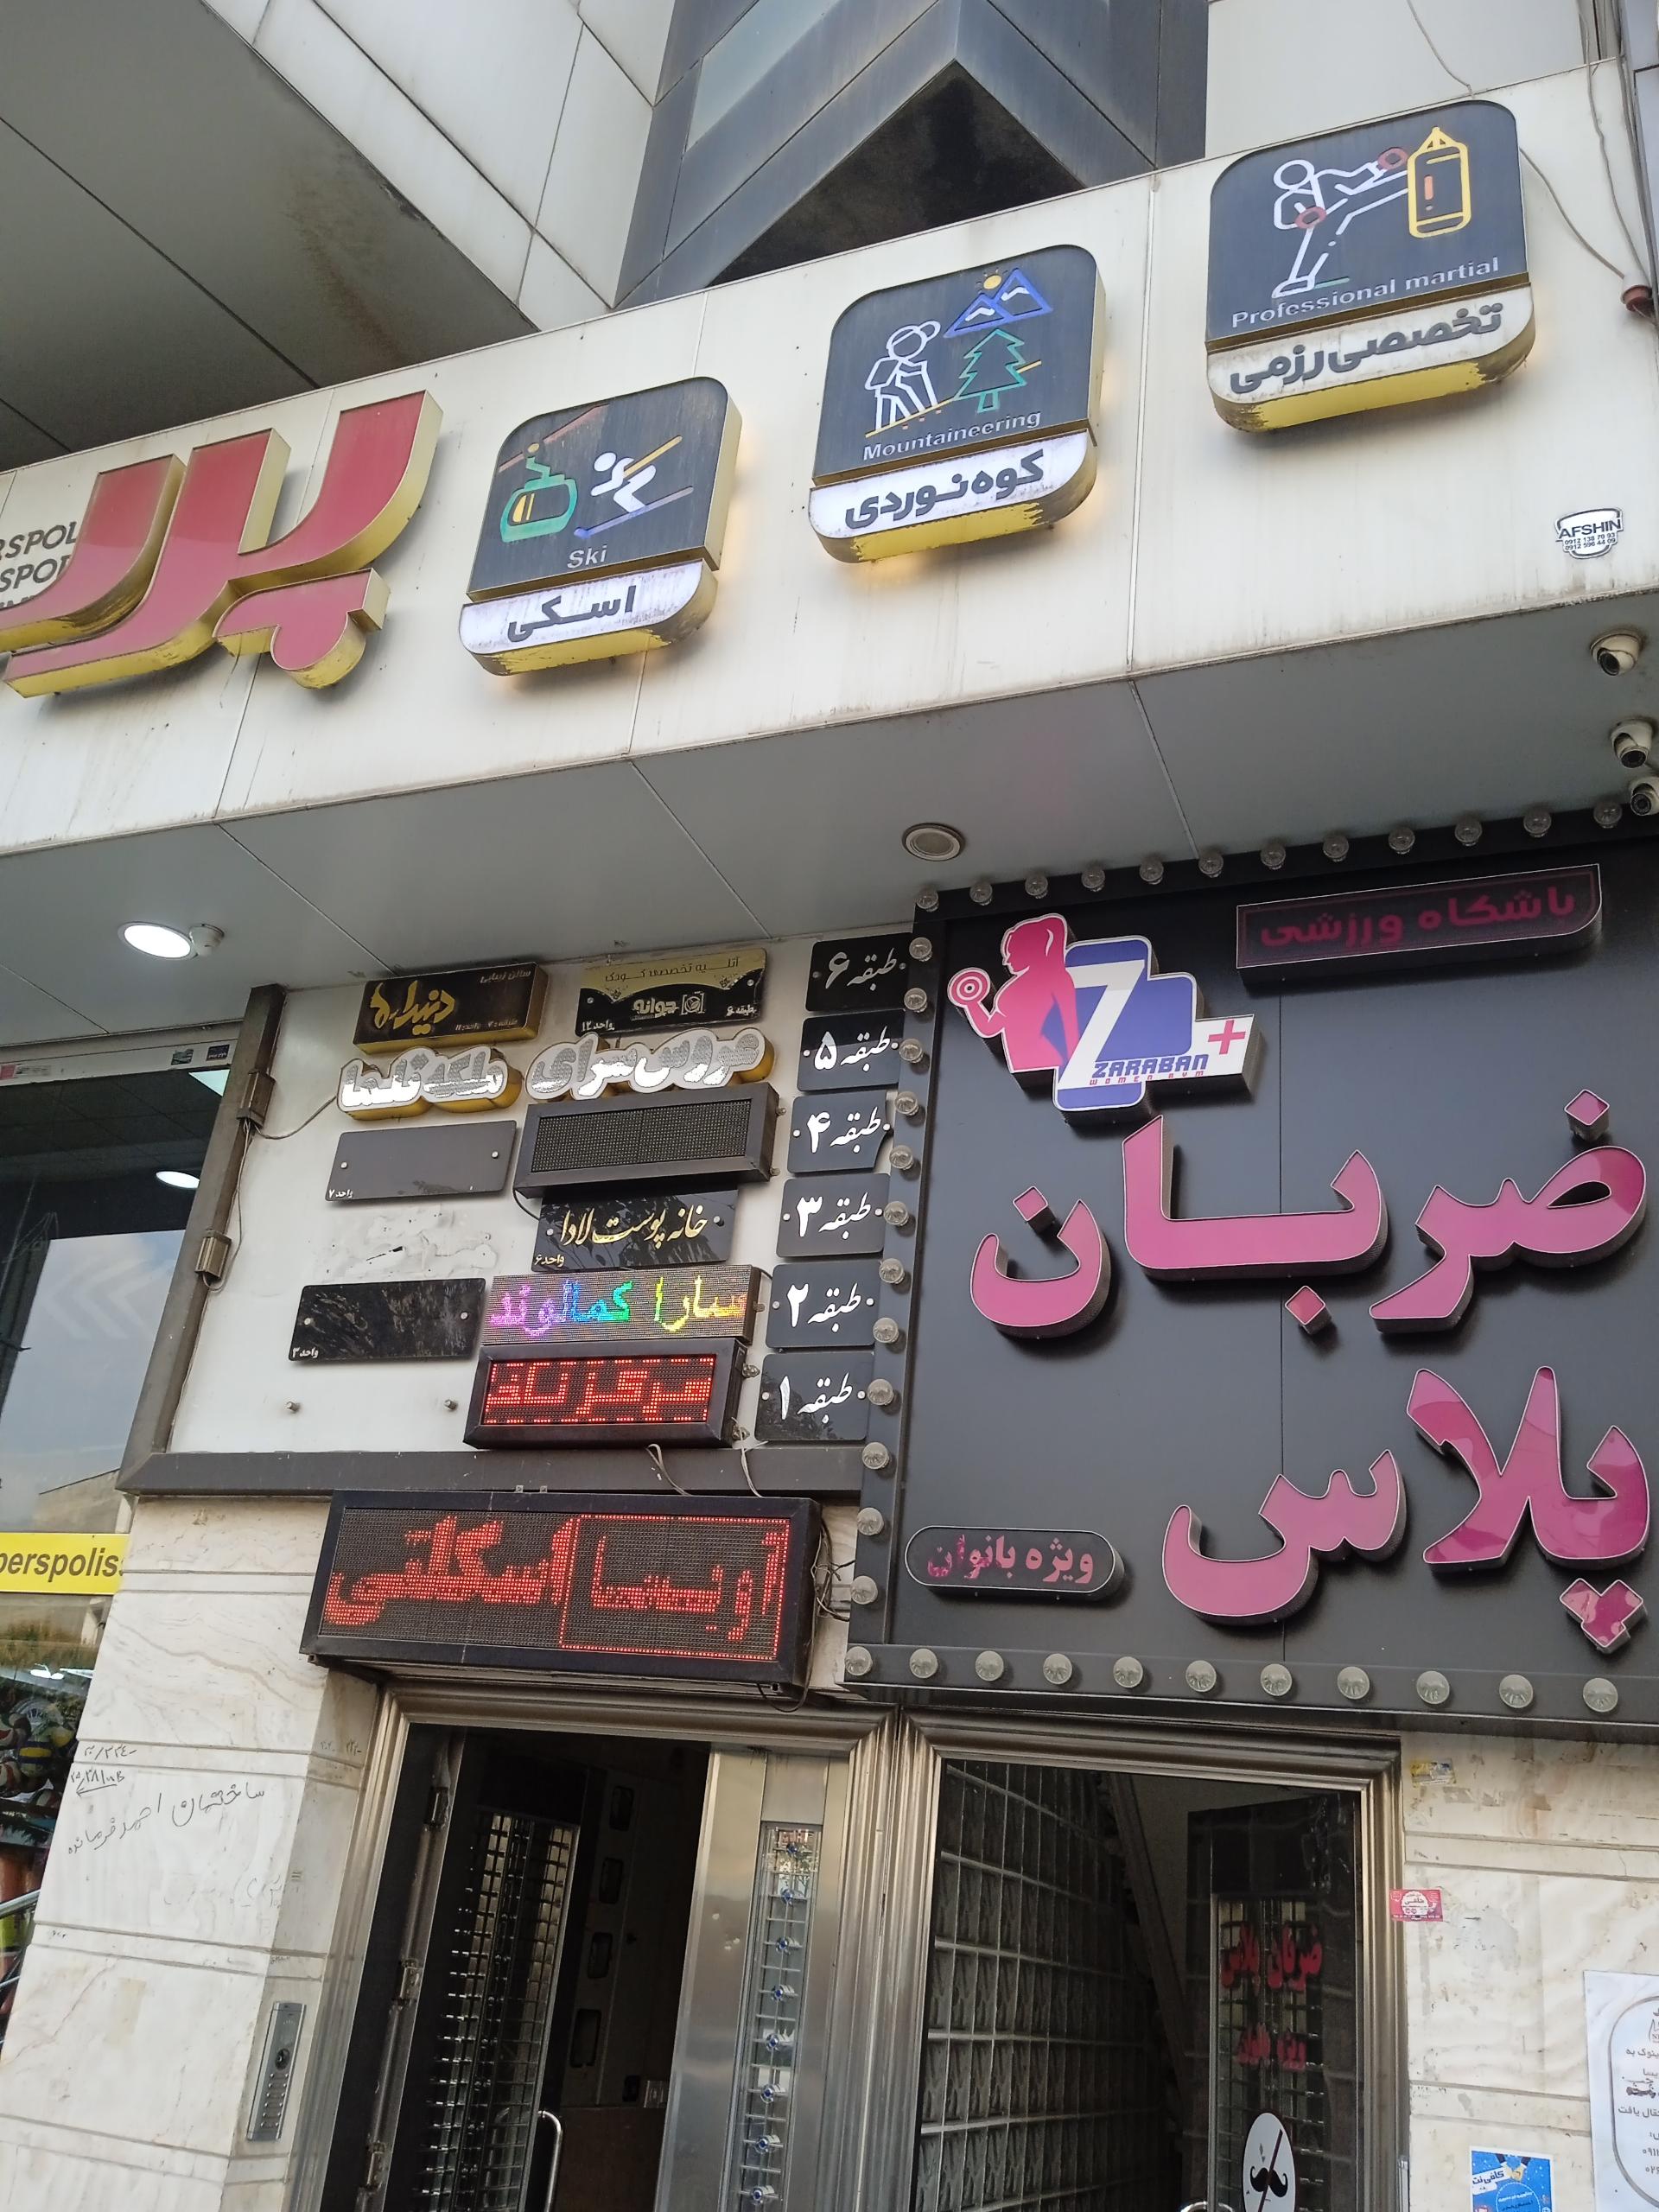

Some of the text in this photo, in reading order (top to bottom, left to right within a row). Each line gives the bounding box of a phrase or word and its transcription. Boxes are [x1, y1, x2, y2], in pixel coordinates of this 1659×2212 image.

[1231, 257, 1499, 328] Professional martial
[863, 410, 1041, 460] Mountaineering
[0, 521, 77, 560] SPOL
[1558, 519, 1622, 539] AFSHIN
[567, 545, 607, 569] Ski
[507, 585, 637, 642] اسکی
[1261, 910, 1405, 950] ورزشی
[825, 947, 898, 991] طبقه ۶
[593, 1019, 615, 1031] واحد
[814, 1026, 891, 1071] طبقه ۵
[1091, 1054, 1209, 1079] ZARABAN
[1089, 1074, 1154, 1086] WOMEN
[806, 1106, 881, 1154] طبقه ۴
[335, 1189, 353, 1198] واحد
[969, 1089, 1647, 1331] ضربان
[592, 1208, 667, 1249] پوست
[667, 1204, 709, 1243] خانه
[797, 1192, 872, 1240] طبقه ۳
[541, 1254, 565, 1268] واحد
[653, 1274, 748, 1332] سارا
[787, 1282, 861, 1332] طبقه ۲
[299, 1347, 319, 1359] واحد
[575, 1369, 712, 1415] مرکز
[779, 1372, 853, 1424] طبقه ۱
[1162, 1365, 1652, 1650] پلاس
[926, 1534, 1094, 1585] ویژه بانوان
[171, 1782, 265, 1827] ساختمان
[1618, 2106, 1641, 2117] یافت
